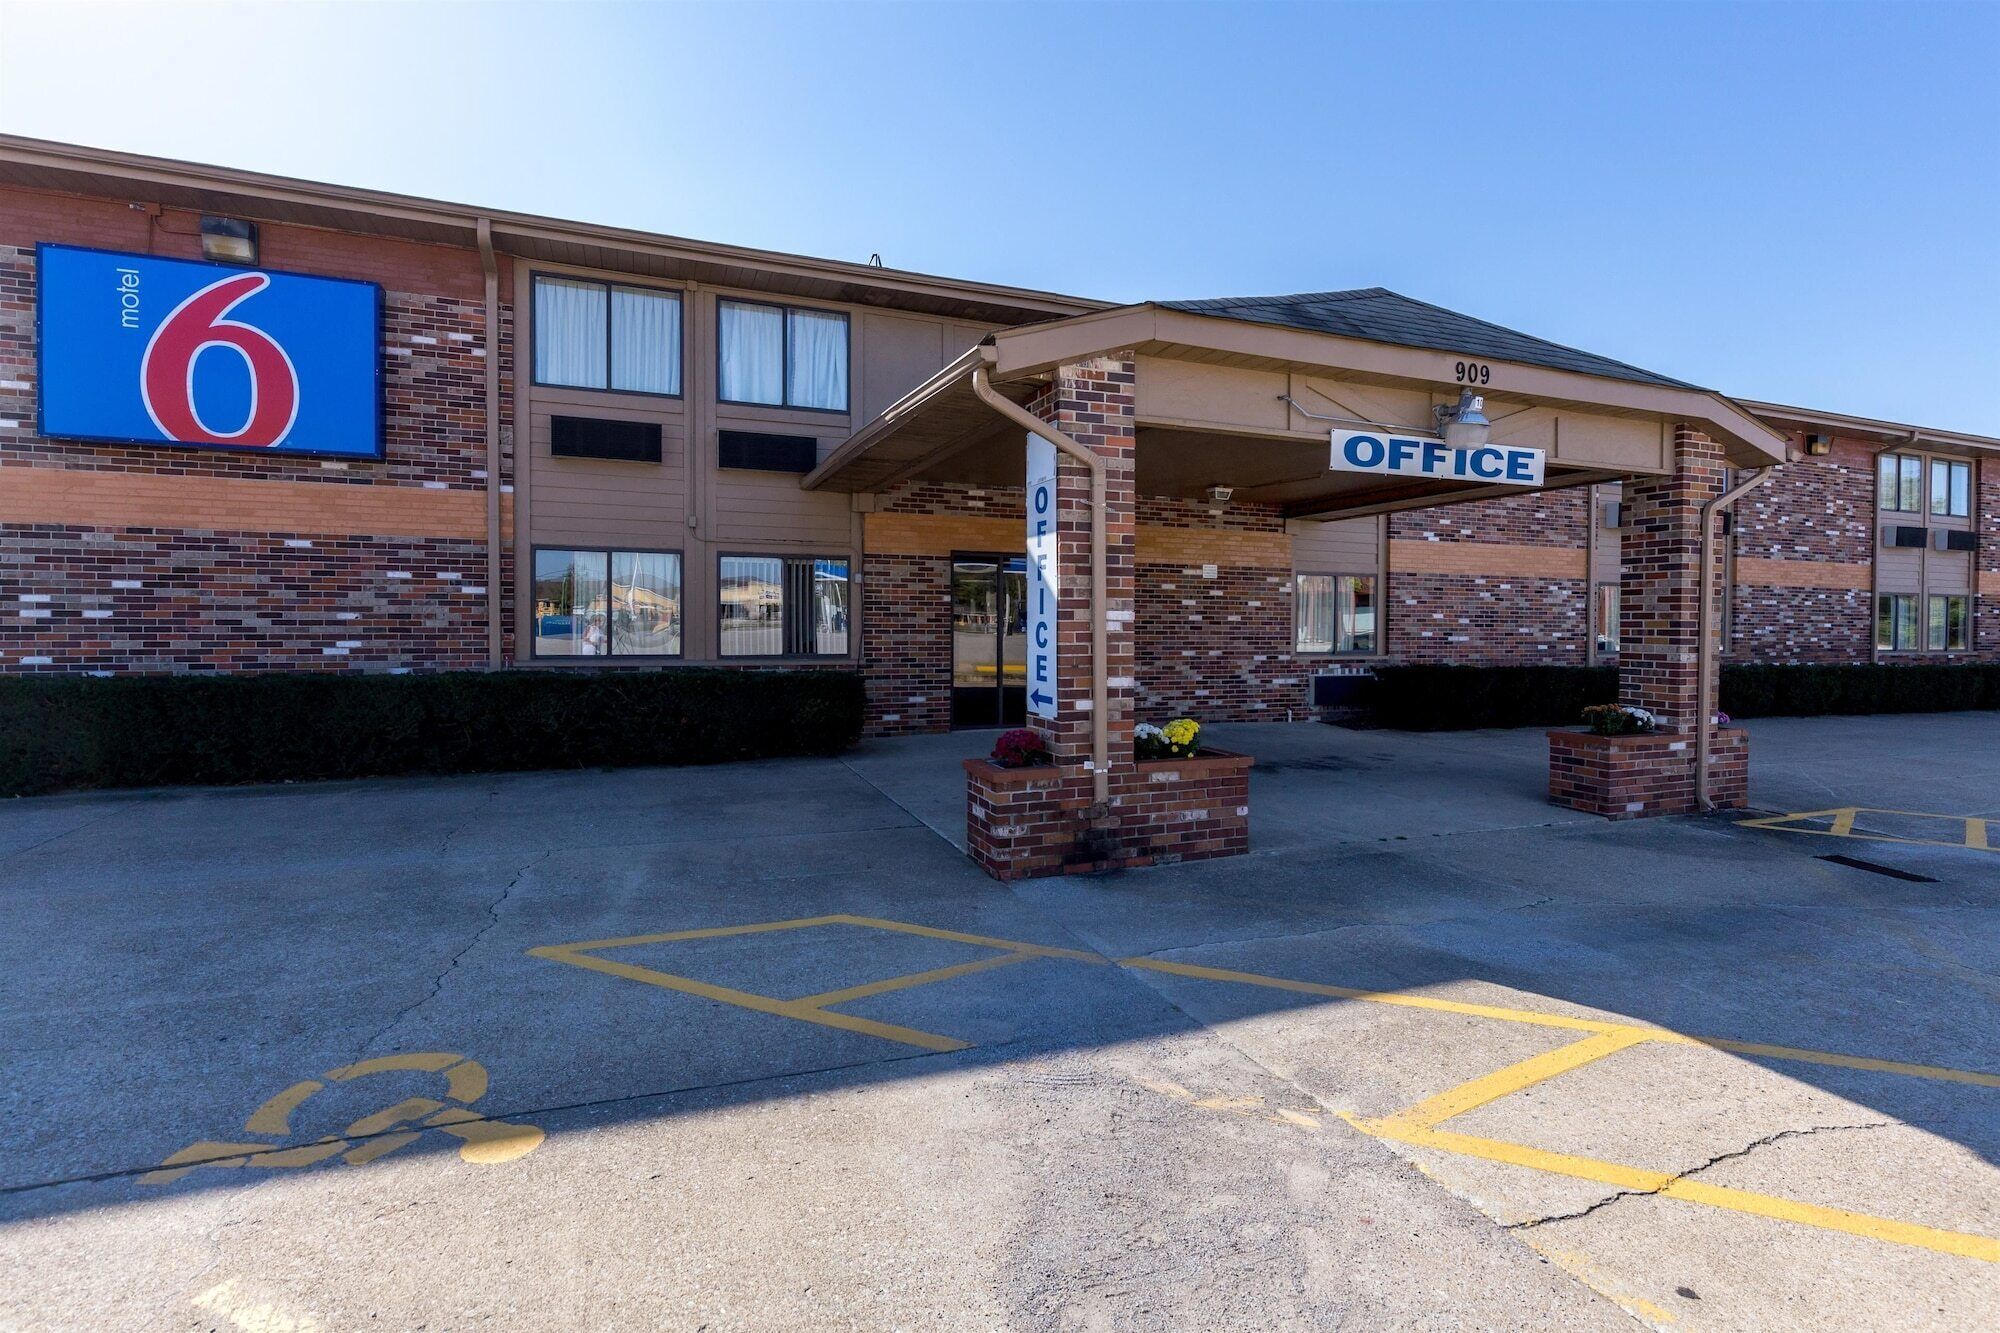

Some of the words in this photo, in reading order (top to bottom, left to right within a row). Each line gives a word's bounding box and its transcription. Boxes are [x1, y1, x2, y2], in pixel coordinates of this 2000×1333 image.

[117, 268, 139, 329] motel
[140, 271, 300, 447] 6
[1455, 361, 1490, 385] 909
[1343, 435, 1535, 481] OFFICE
[1034, 486, 1048, 682] OFFICE
